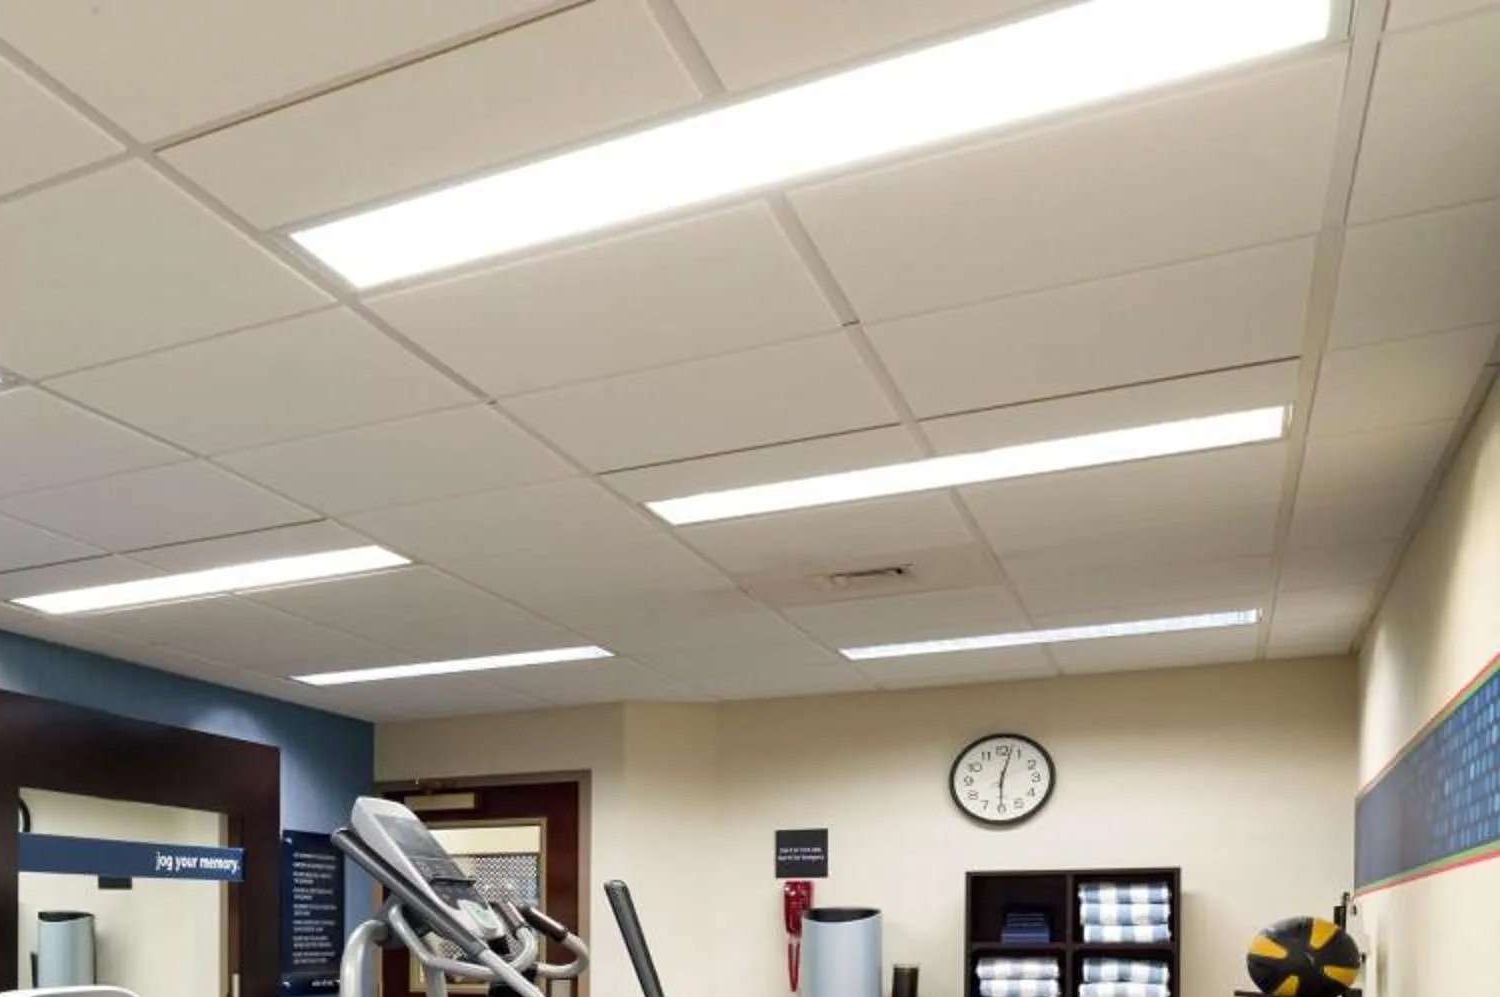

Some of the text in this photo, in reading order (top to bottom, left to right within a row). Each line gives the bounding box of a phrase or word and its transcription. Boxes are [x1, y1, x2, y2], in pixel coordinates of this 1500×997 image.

[155, 851, 241, 875] jog your memory.
